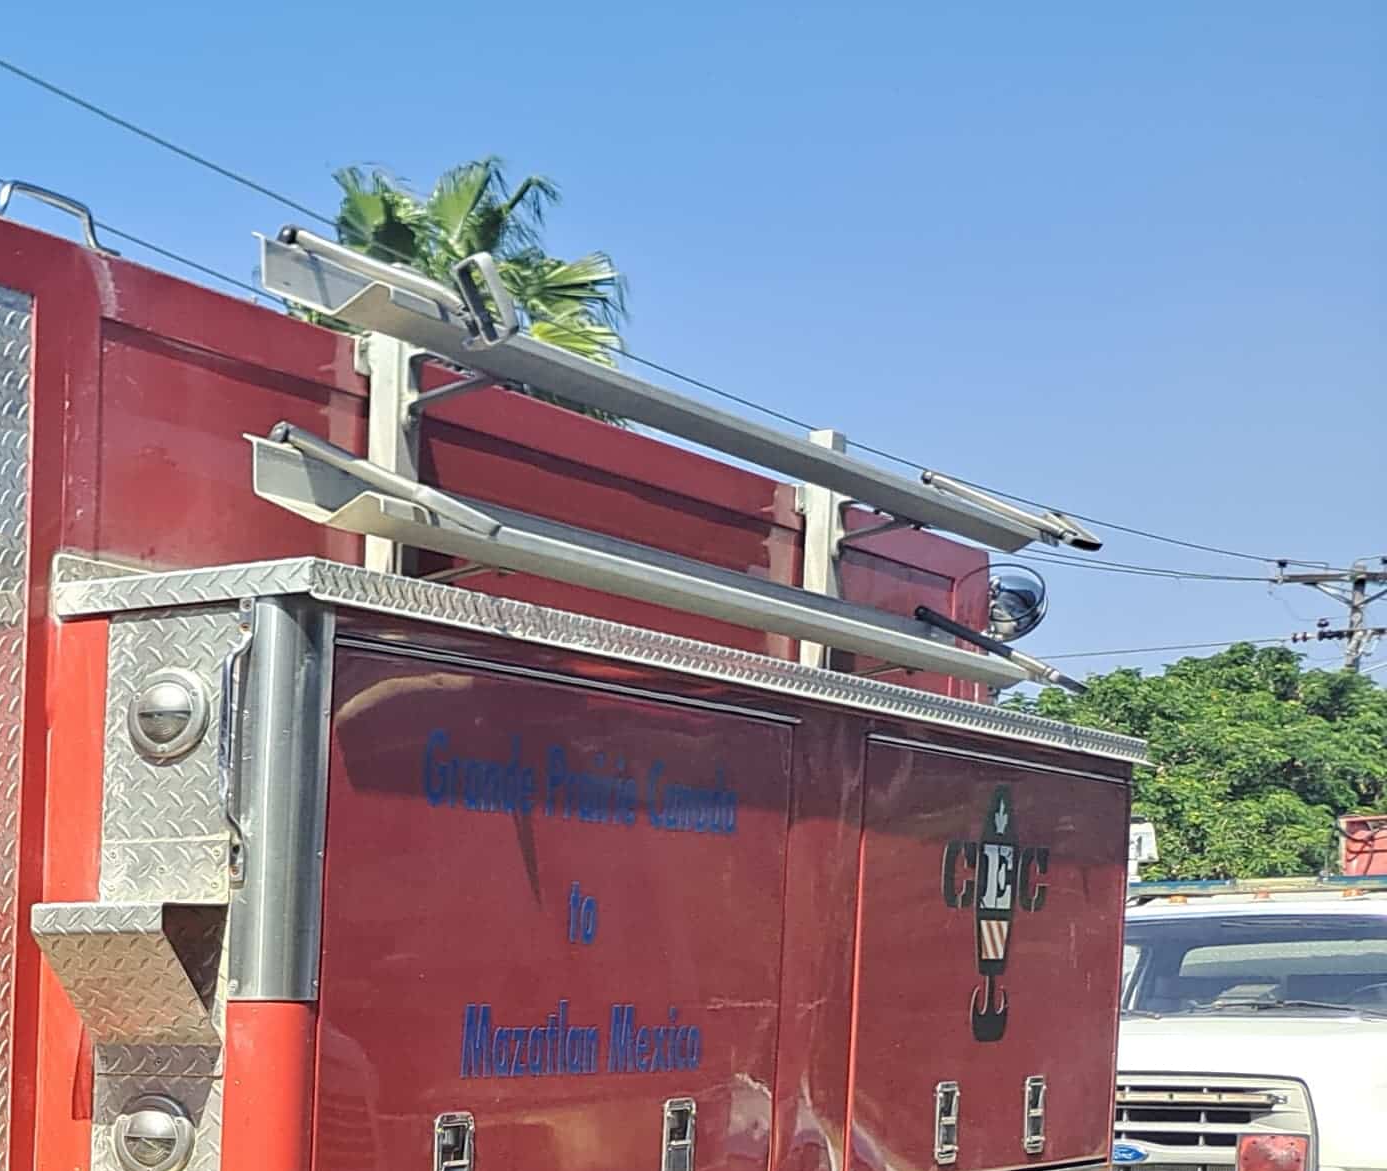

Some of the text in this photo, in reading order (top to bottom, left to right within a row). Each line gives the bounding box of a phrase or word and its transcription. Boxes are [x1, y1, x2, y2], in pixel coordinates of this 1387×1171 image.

[423, 729, 534, 815] Grande
[648, 759, 738, 834] Canada
[568, 881, 597, 945] to
[460, 1000, 701, 1078] Mazatlan Mexico
